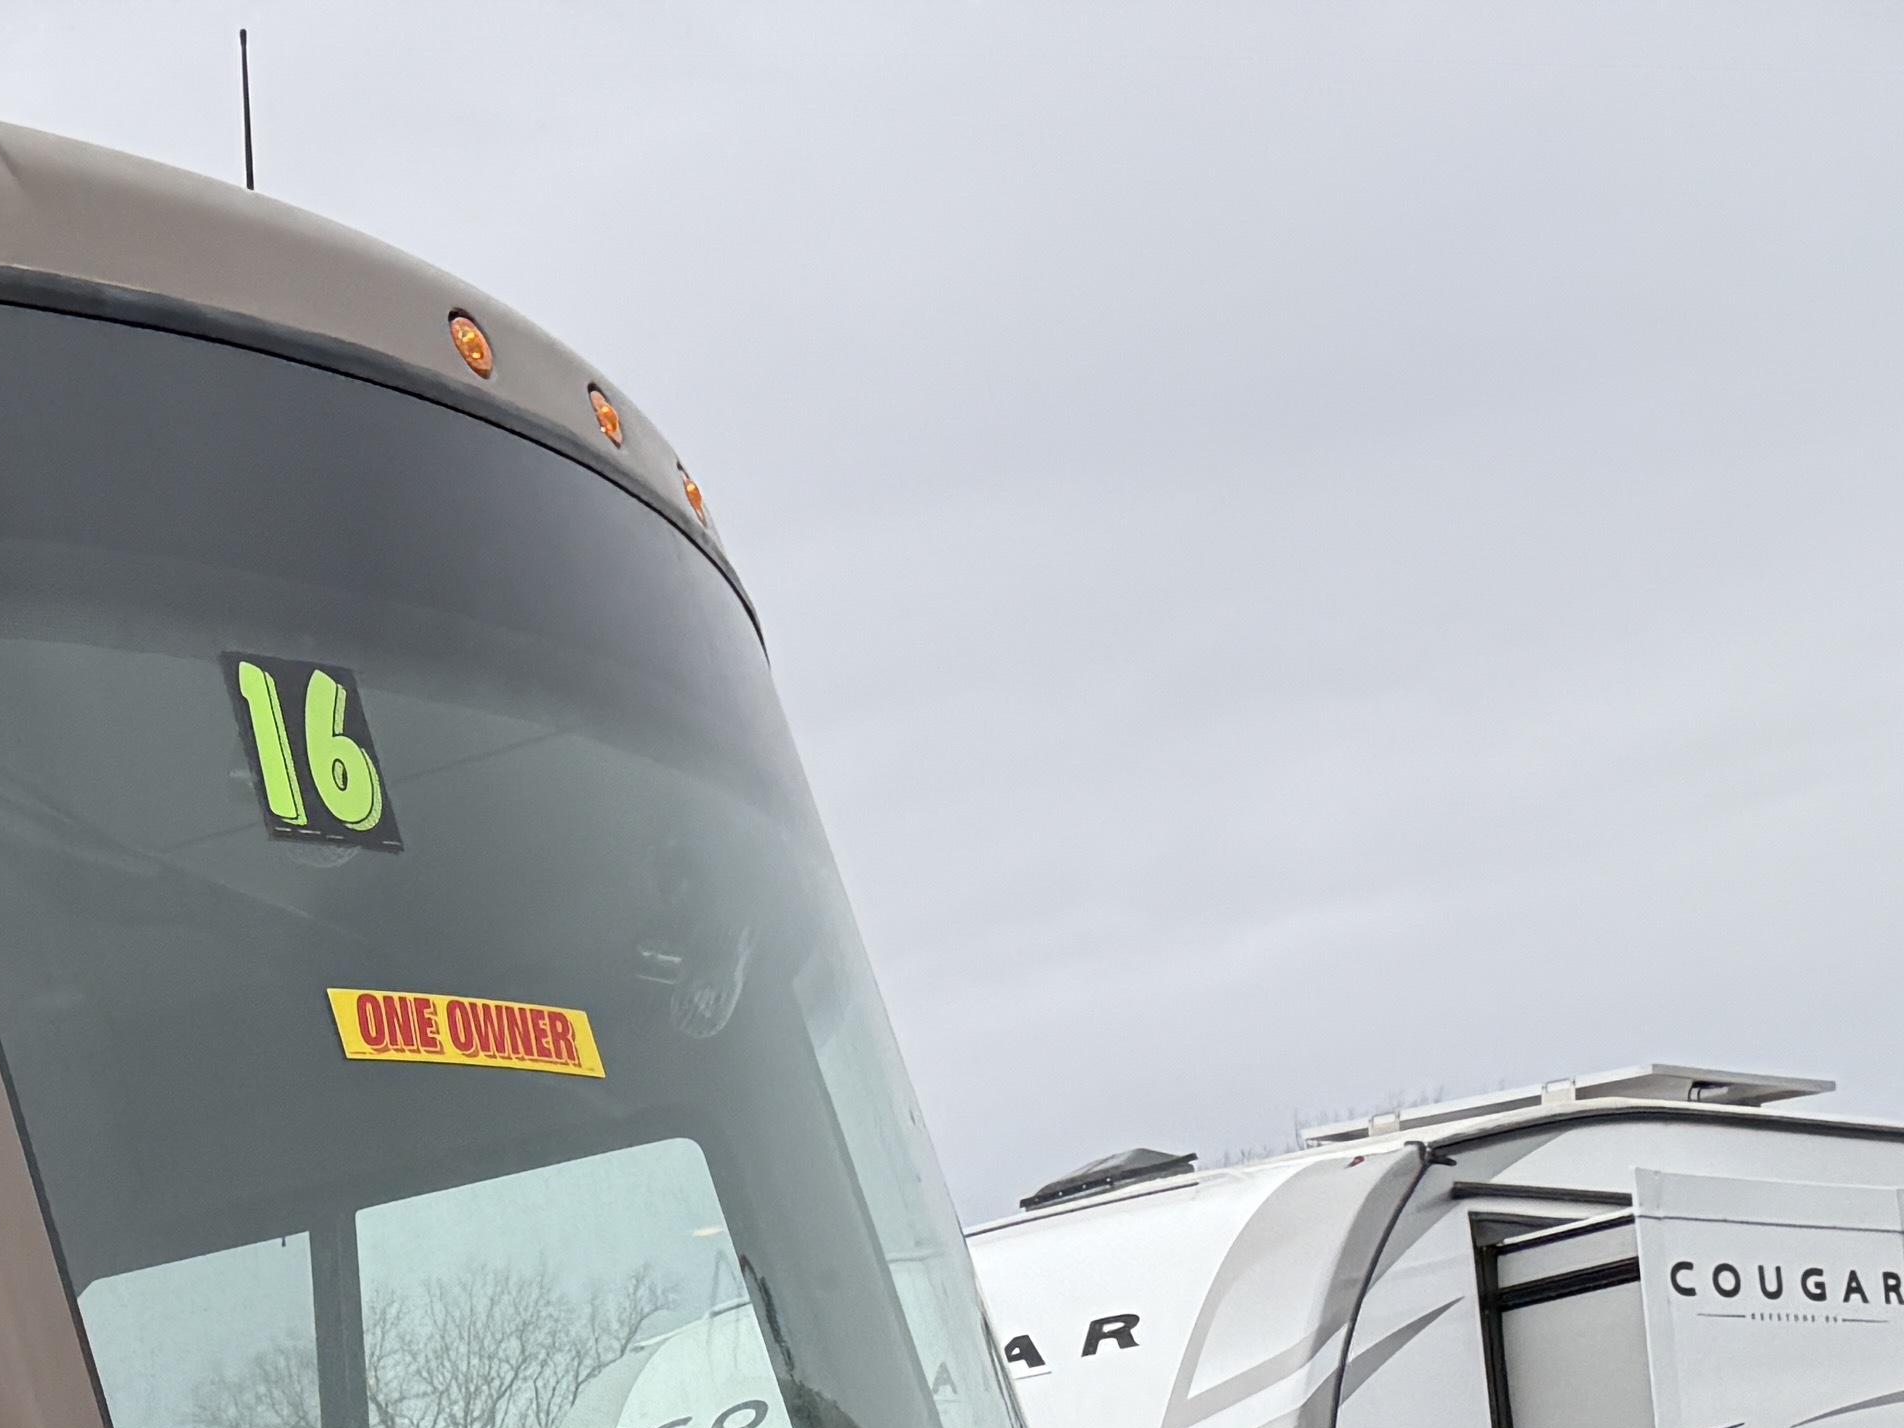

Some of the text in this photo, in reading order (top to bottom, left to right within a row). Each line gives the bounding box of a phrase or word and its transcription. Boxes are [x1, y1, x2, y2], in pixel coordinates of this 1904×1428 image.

[238, 660, 383, 832] 16
[356, 993, 582, 1068] ONE OWNER
[1670, 1260, 1904, 1306] COUGAR
